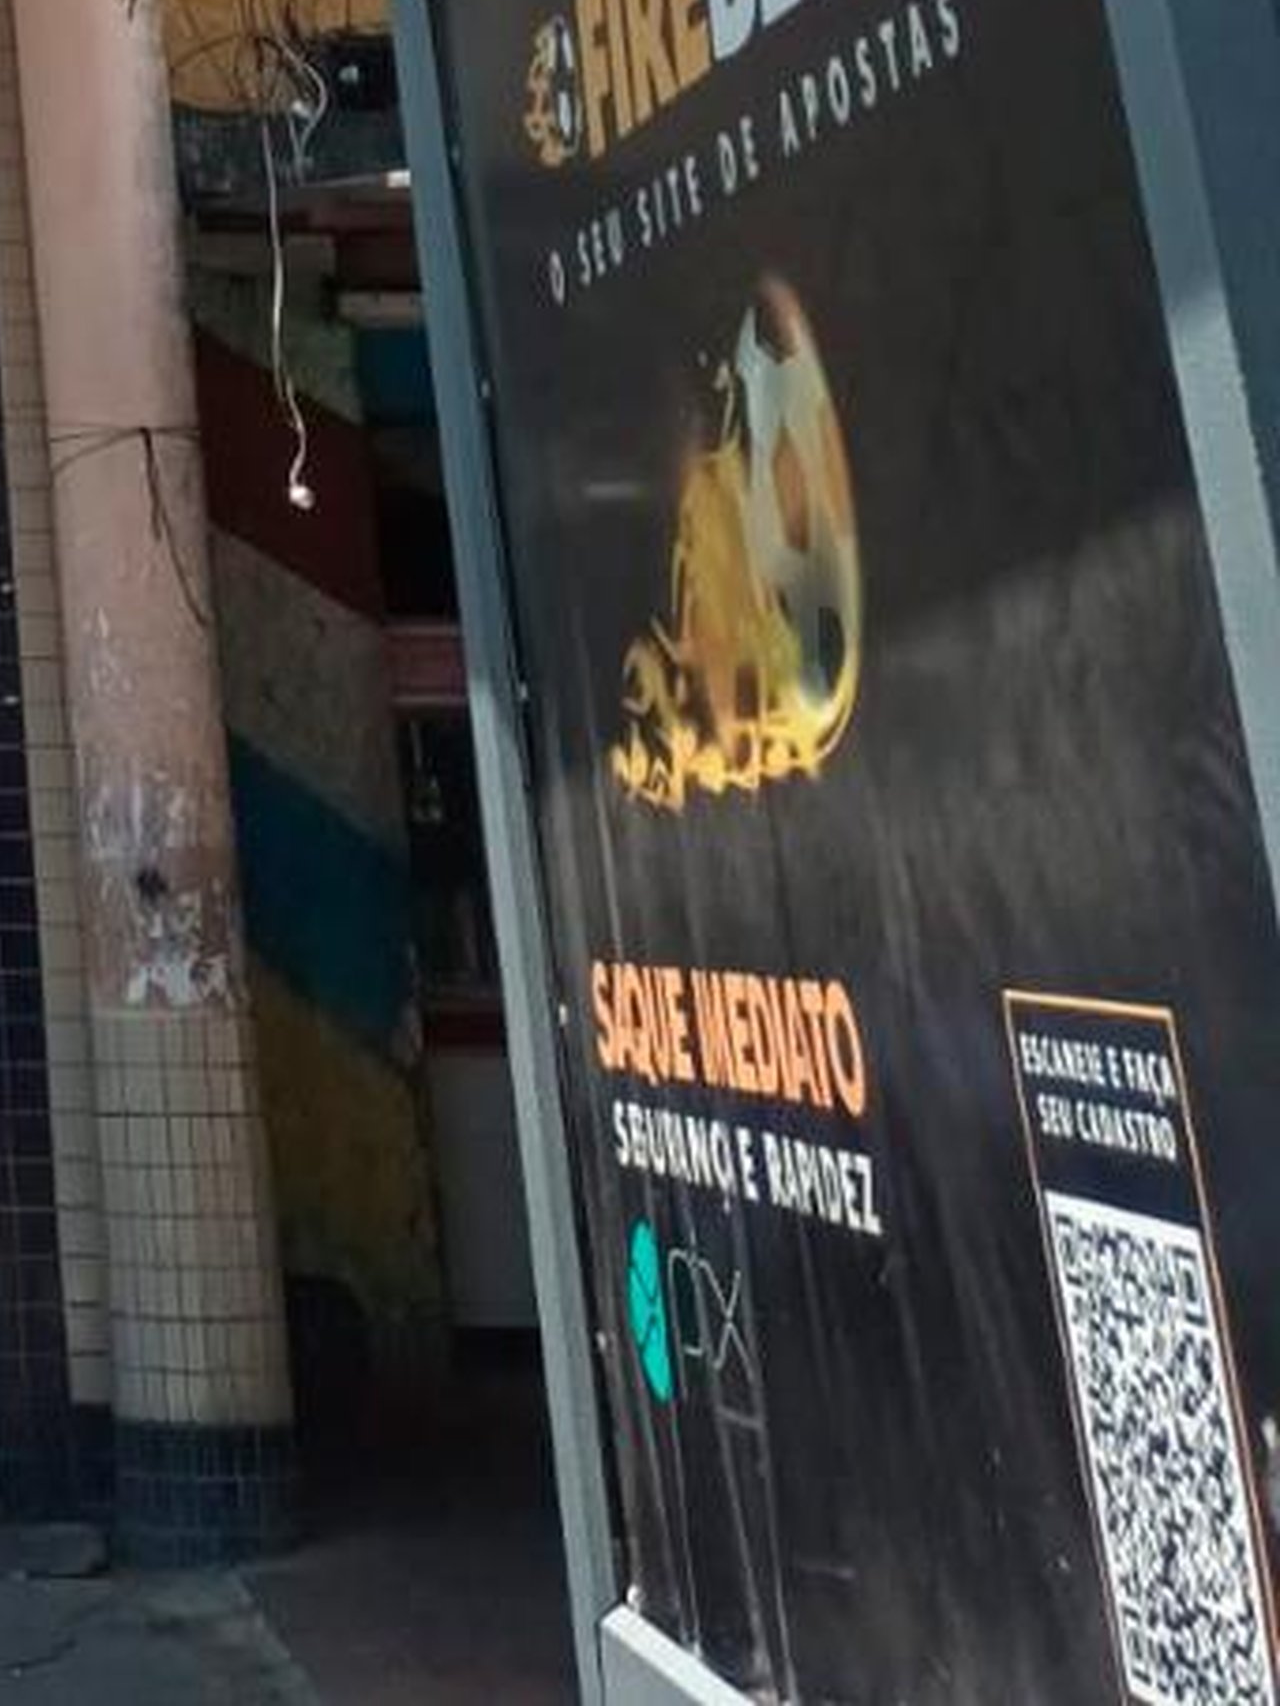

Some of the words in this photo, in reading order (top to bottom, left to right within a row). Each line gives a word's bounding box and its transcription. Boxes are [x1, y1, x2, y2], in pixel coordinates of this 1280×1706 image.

[549, 250, 565, 307] O
[576, 209, 624, 286] SEU
[639, 155, 702, 248] SITE
[718, 116, 760, 195] DE
[593, 960, 695, 1085] SAQUE
[1106, 1046, 1121, 1088] E
[736, 1125, 758, 1201] E
